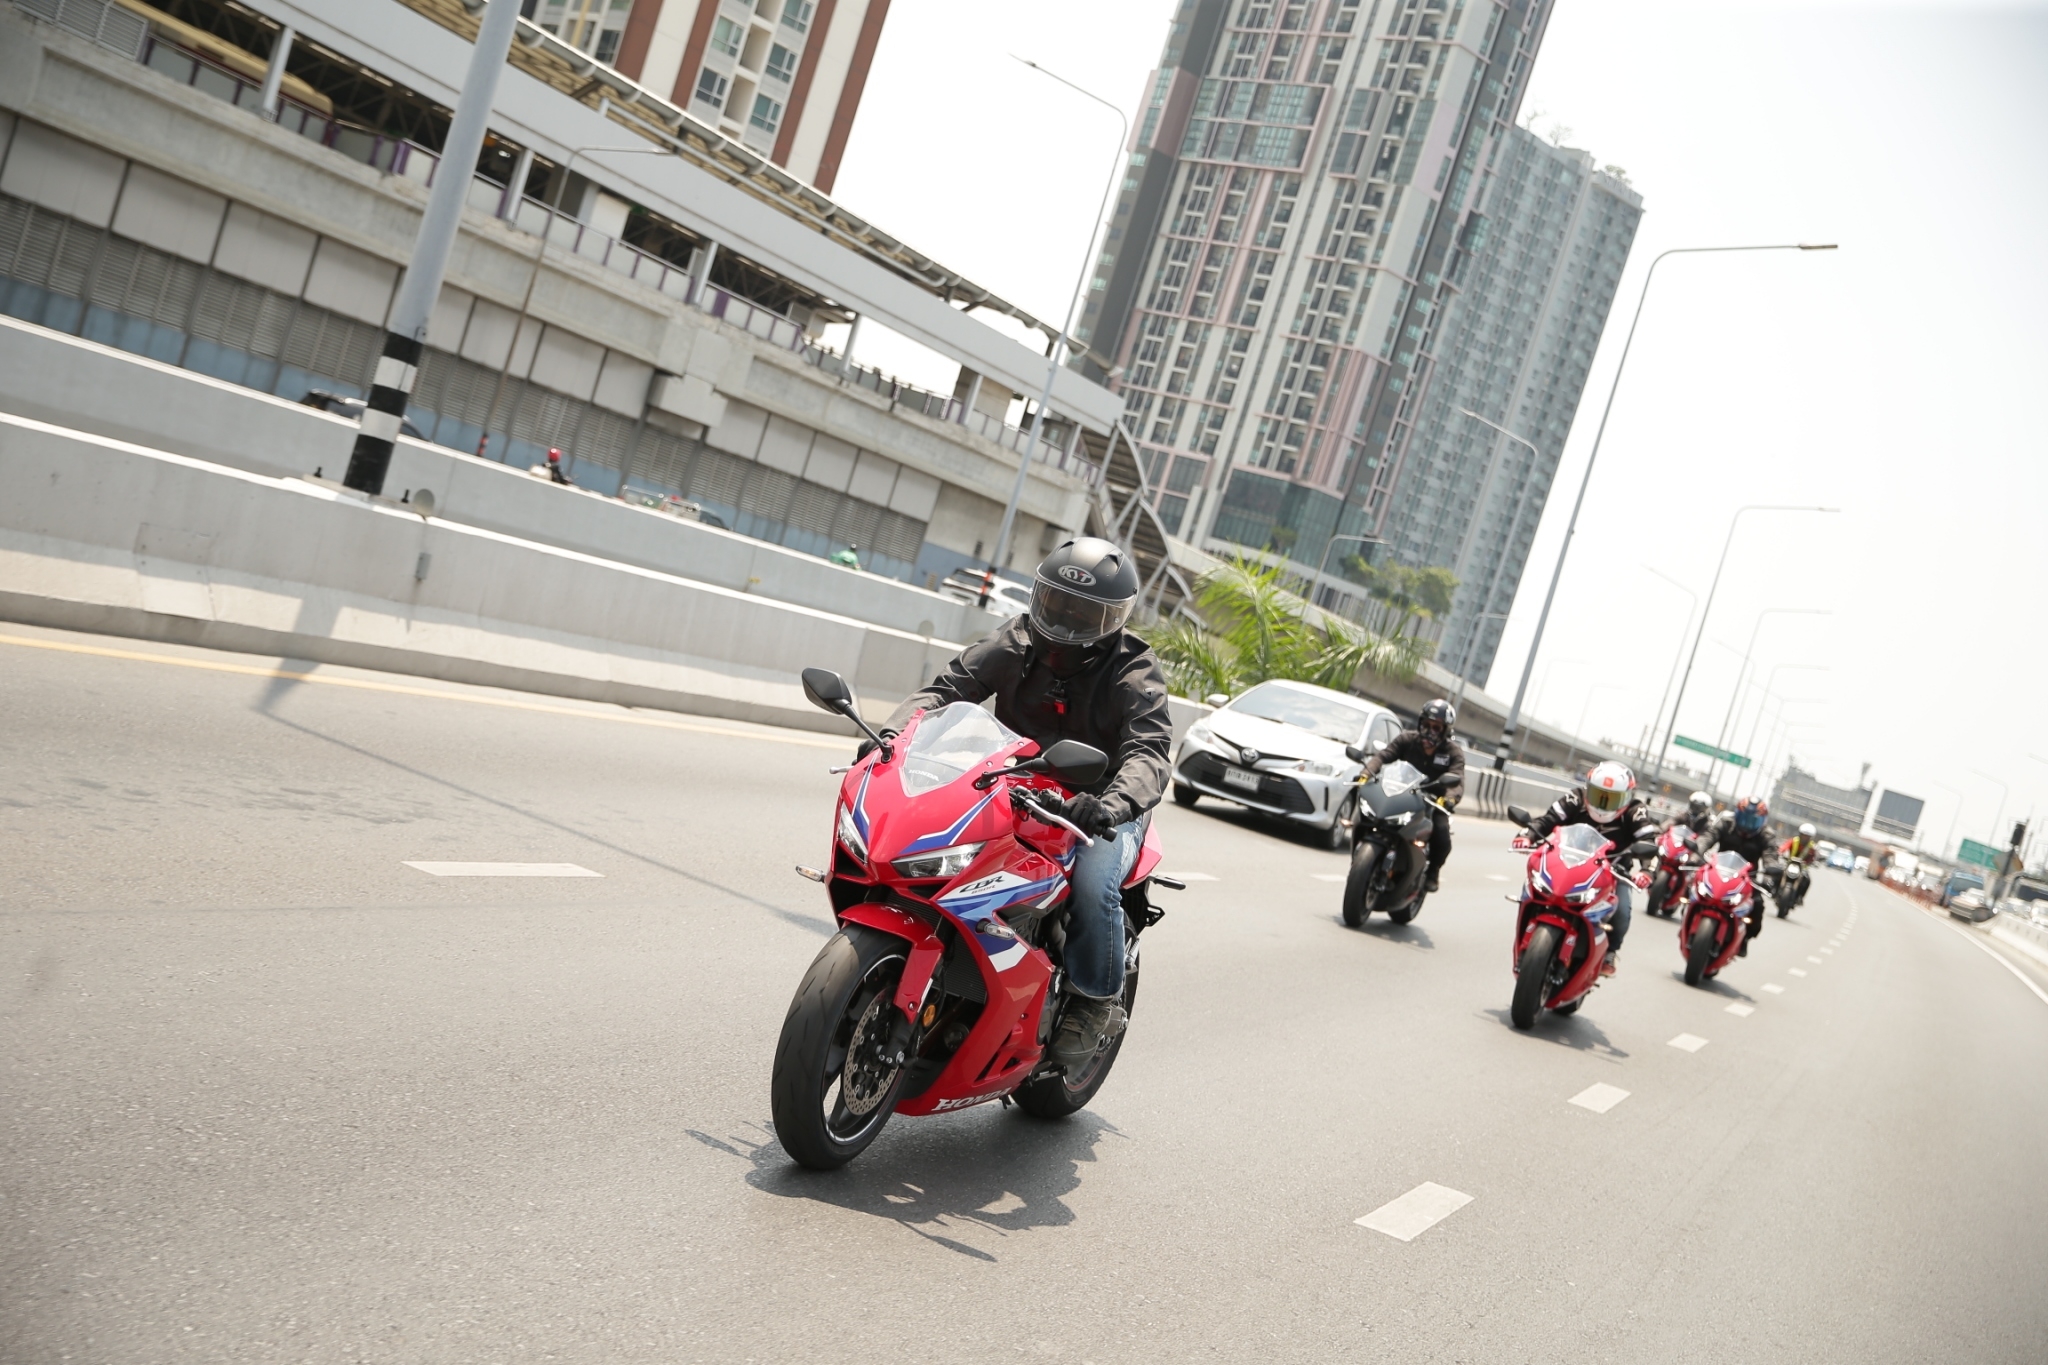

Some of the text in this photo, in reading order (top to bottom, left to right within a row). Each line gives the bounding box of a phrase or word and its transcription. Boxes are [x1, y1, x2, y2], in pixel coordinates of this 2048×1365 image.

[1060, 566, 1093, 583] KYT
[908, 769, 939, 781] HONDA
[959, 876, 1004, 893] CBR
[931, 1087, 1012, 1111] HONDA
